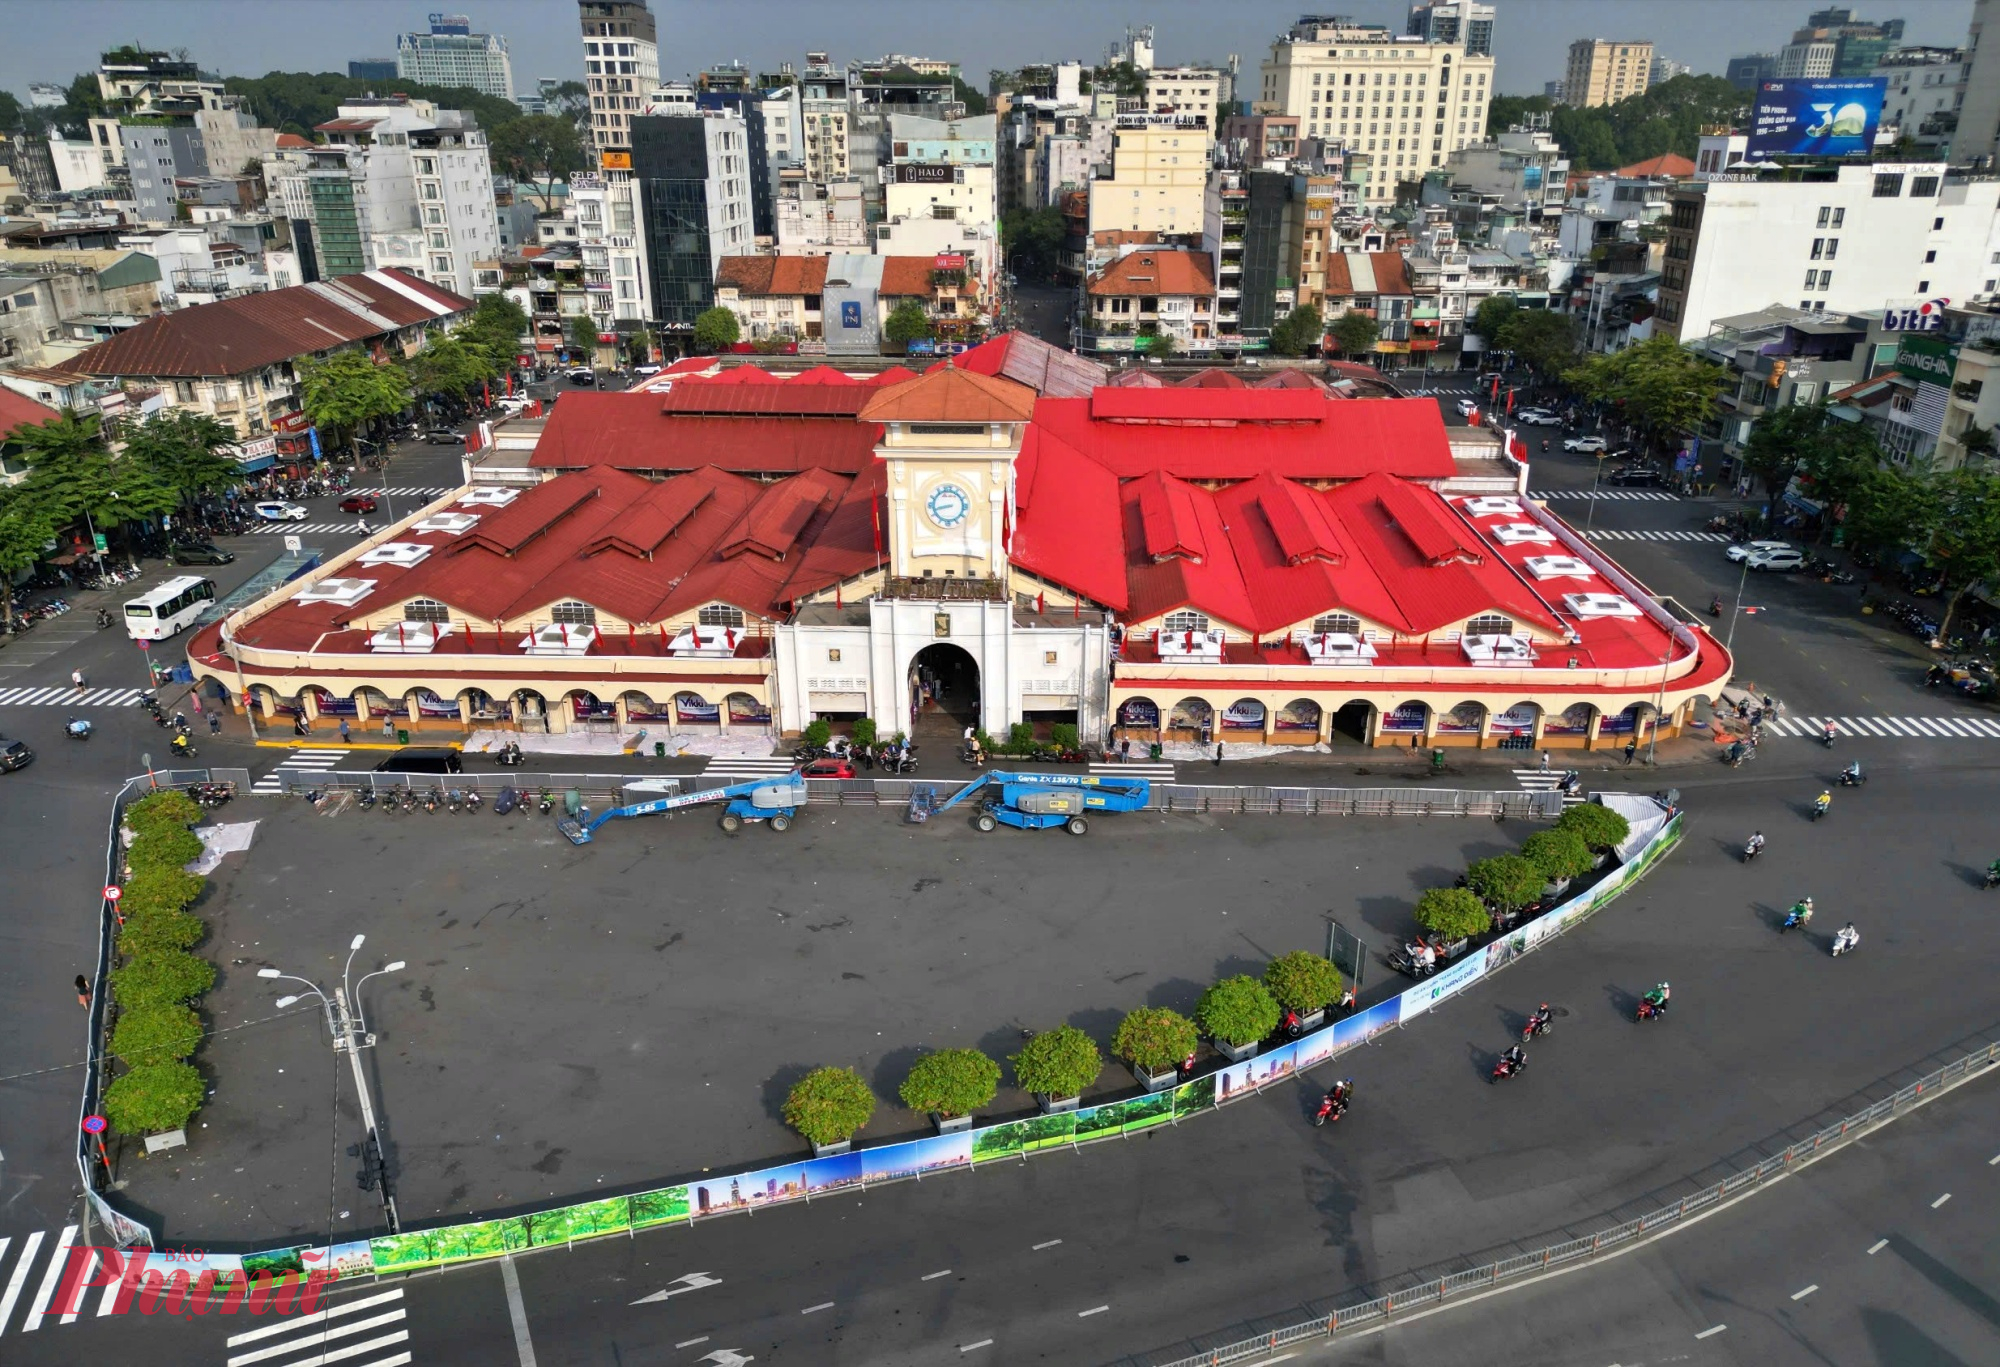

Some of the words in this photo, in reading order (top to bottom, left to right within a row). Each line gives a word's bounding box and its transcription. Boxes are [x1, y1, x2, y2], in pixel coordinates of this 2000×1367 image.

[918, 168, 944, 177] HALO
[1708, 174, 1738, 182] OZONE
[1740, 174, 1757, 182] BAR
[844, 315, 859, 324] PNJ
[680, 695, 704, 708] Vikki
[1228, 703, 1249, 715] Vikki
[1018, 775, 1038, 783] Genie
[636, 803, 656, 814] S-85
[1441, 975, 1463, 992] KHANG
